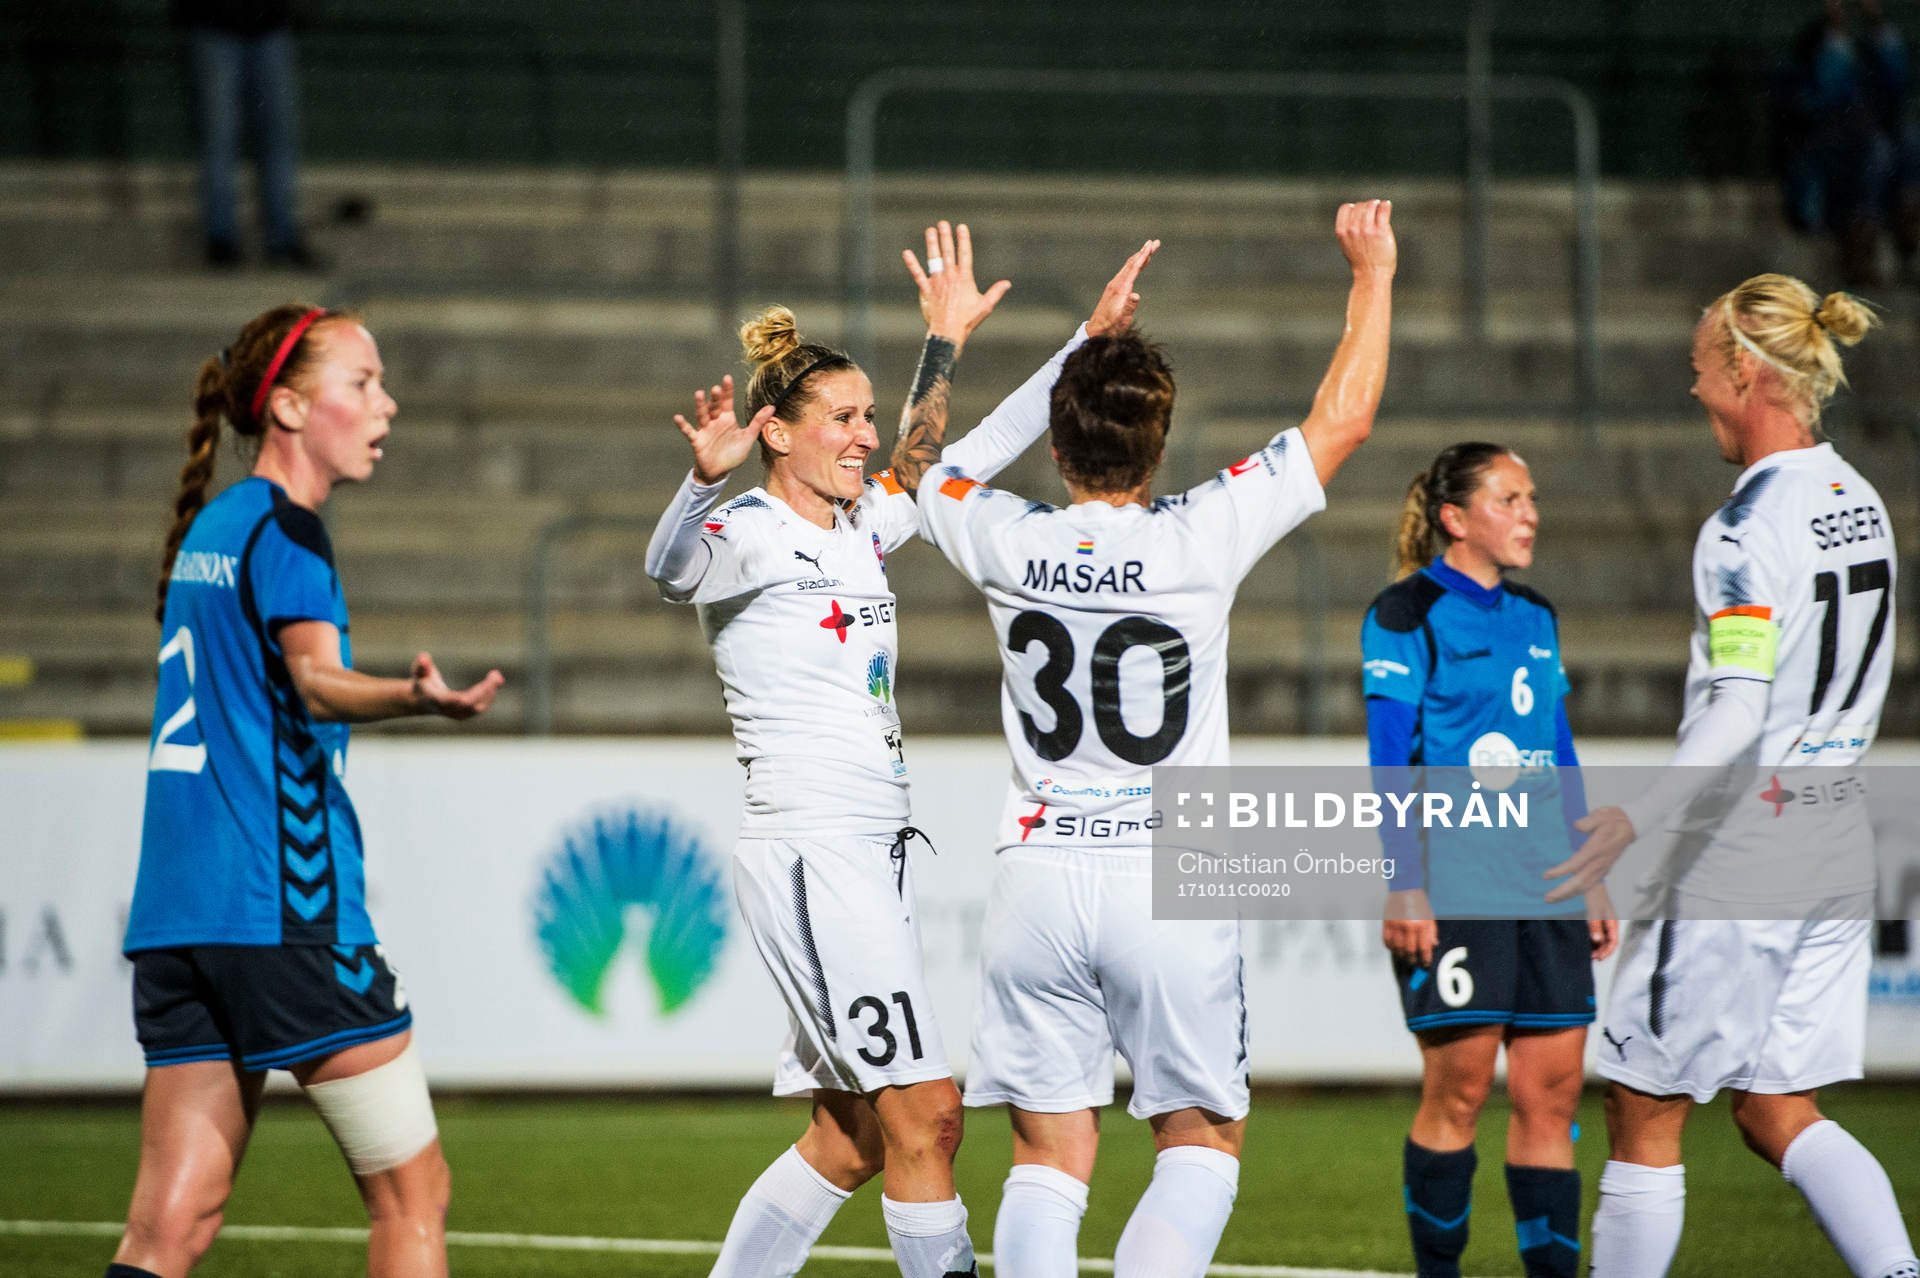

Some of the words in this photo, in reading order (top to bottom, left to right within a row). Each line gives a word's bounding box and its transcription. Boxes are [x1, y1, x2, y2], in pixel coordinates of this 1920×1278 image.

[1811, 505, 1885, 551] SEGER
[1022, 559, 1147, 593] MASAR
[859, 602, 895, 627] SIG
[1808, 558, 1890, 716] 17
[149, 626, 207, 775] 2
[1007, 609, 1191, 766] 30
[1511, 666, 1535, 717] 6
[1051, 785, 1110, 798] Domino's
[1436, 946, 1474, 1008] 6
[847, 990, 924, 1068] 31
